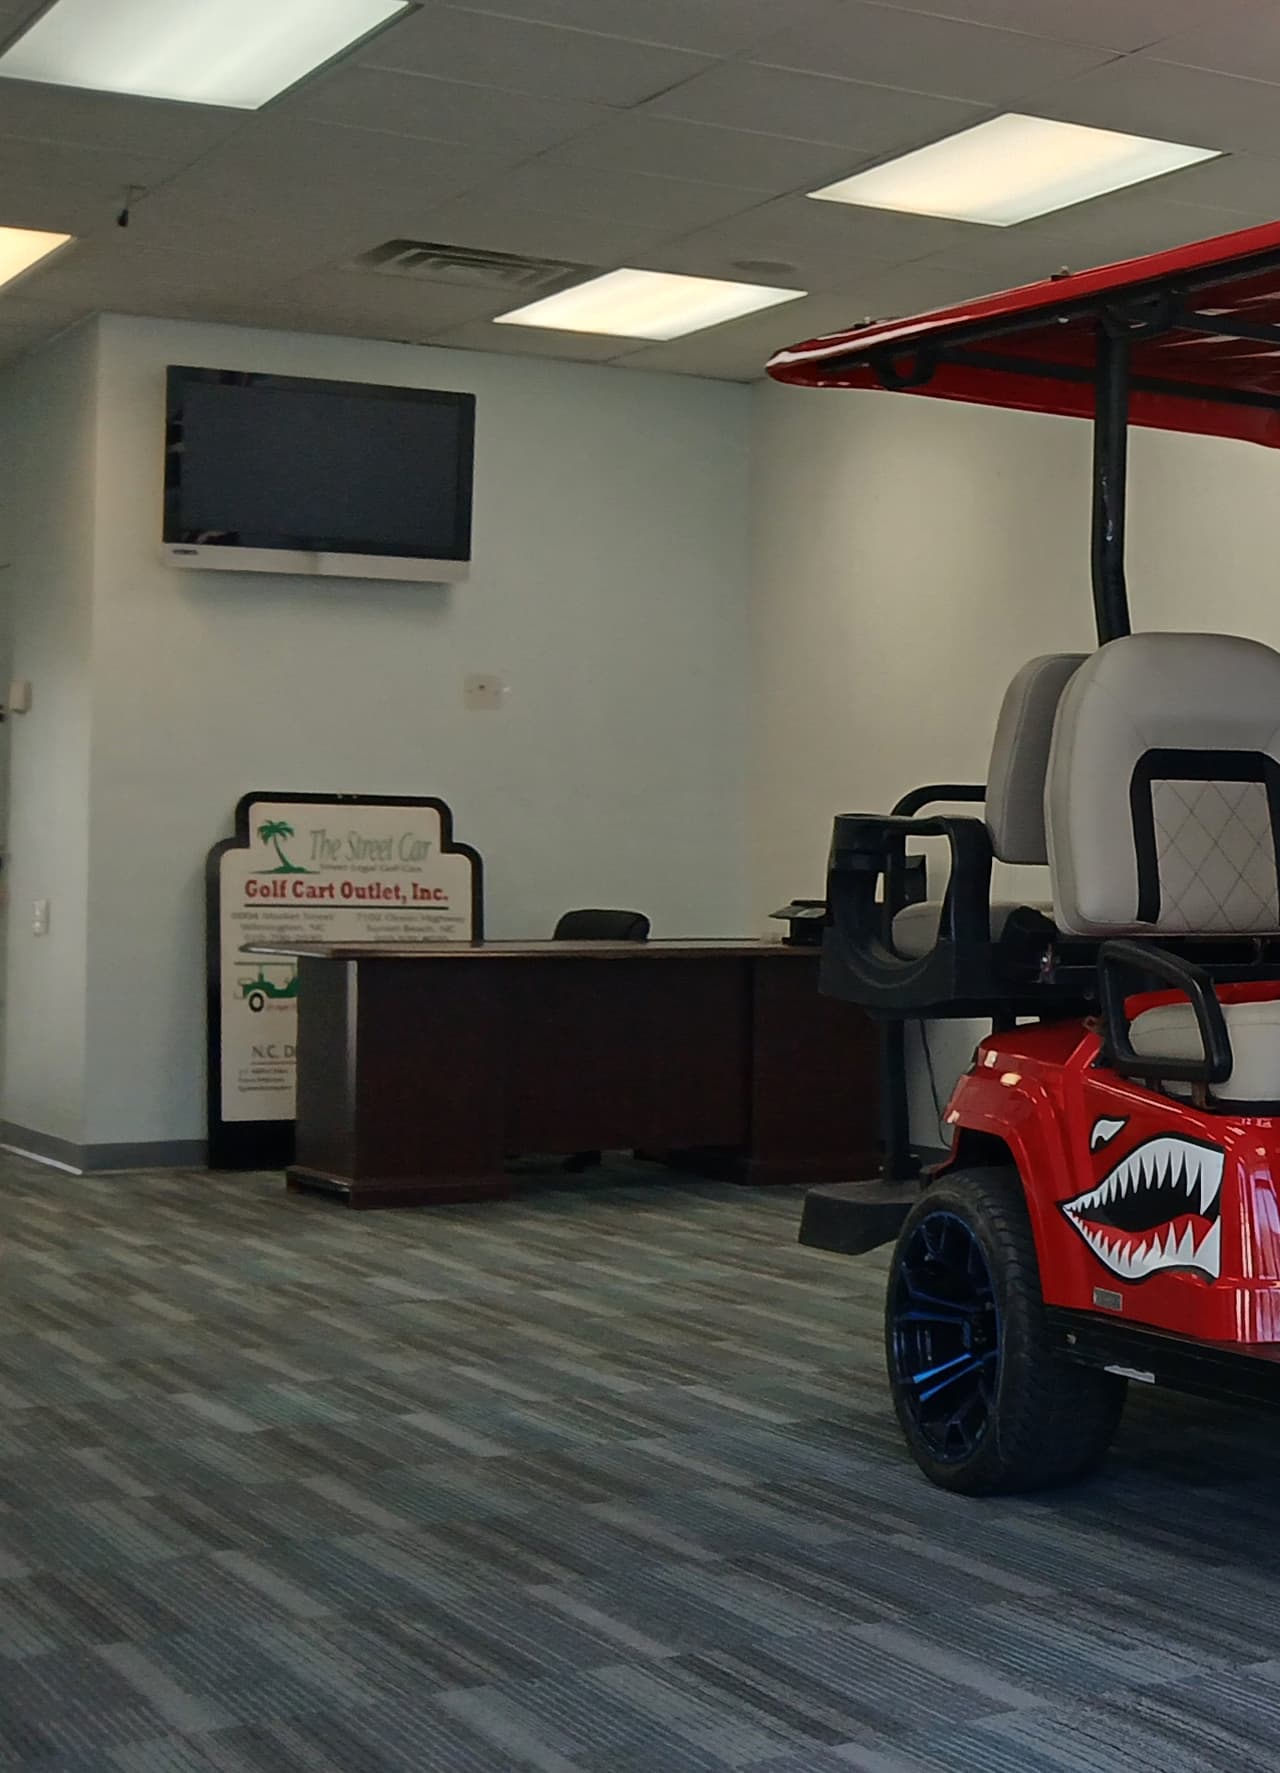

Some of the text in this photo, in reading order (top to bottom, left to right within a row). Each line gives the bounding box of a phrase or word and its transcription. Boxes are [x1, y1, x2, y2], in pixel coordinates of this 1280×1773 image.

[309, 829, 432, 862] The Street Car
[244, 879, 449, 904] Golf Cart Outlet, Inc.
